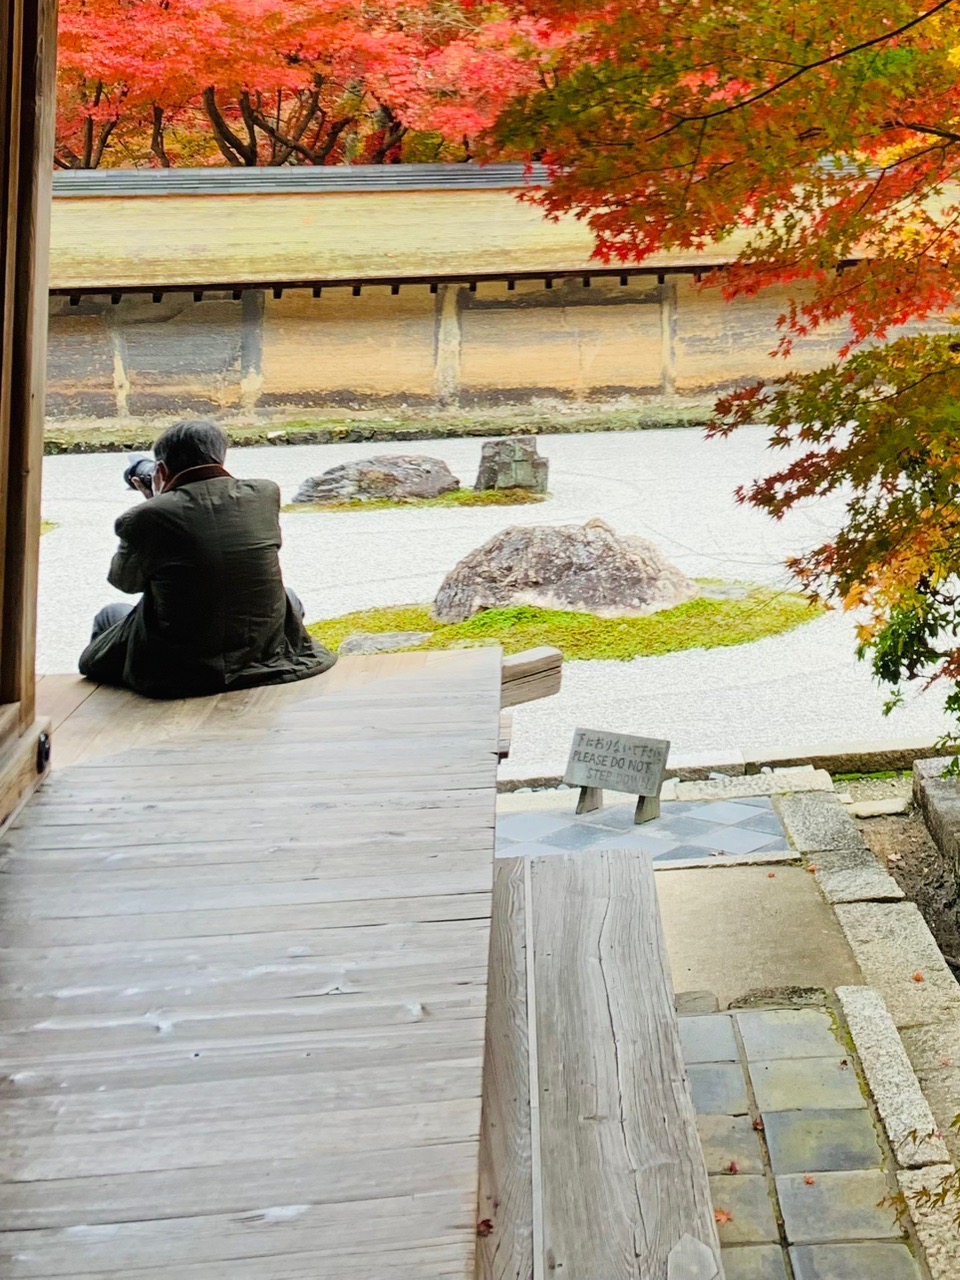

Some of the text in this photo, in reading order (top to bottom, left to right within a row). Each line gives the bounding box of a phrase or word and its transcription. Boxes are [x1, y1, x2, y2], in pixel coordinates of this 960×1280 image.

[573, 750, 653, 774] PLEASE DO NOT
[586, 767, 612, 781] STEP
